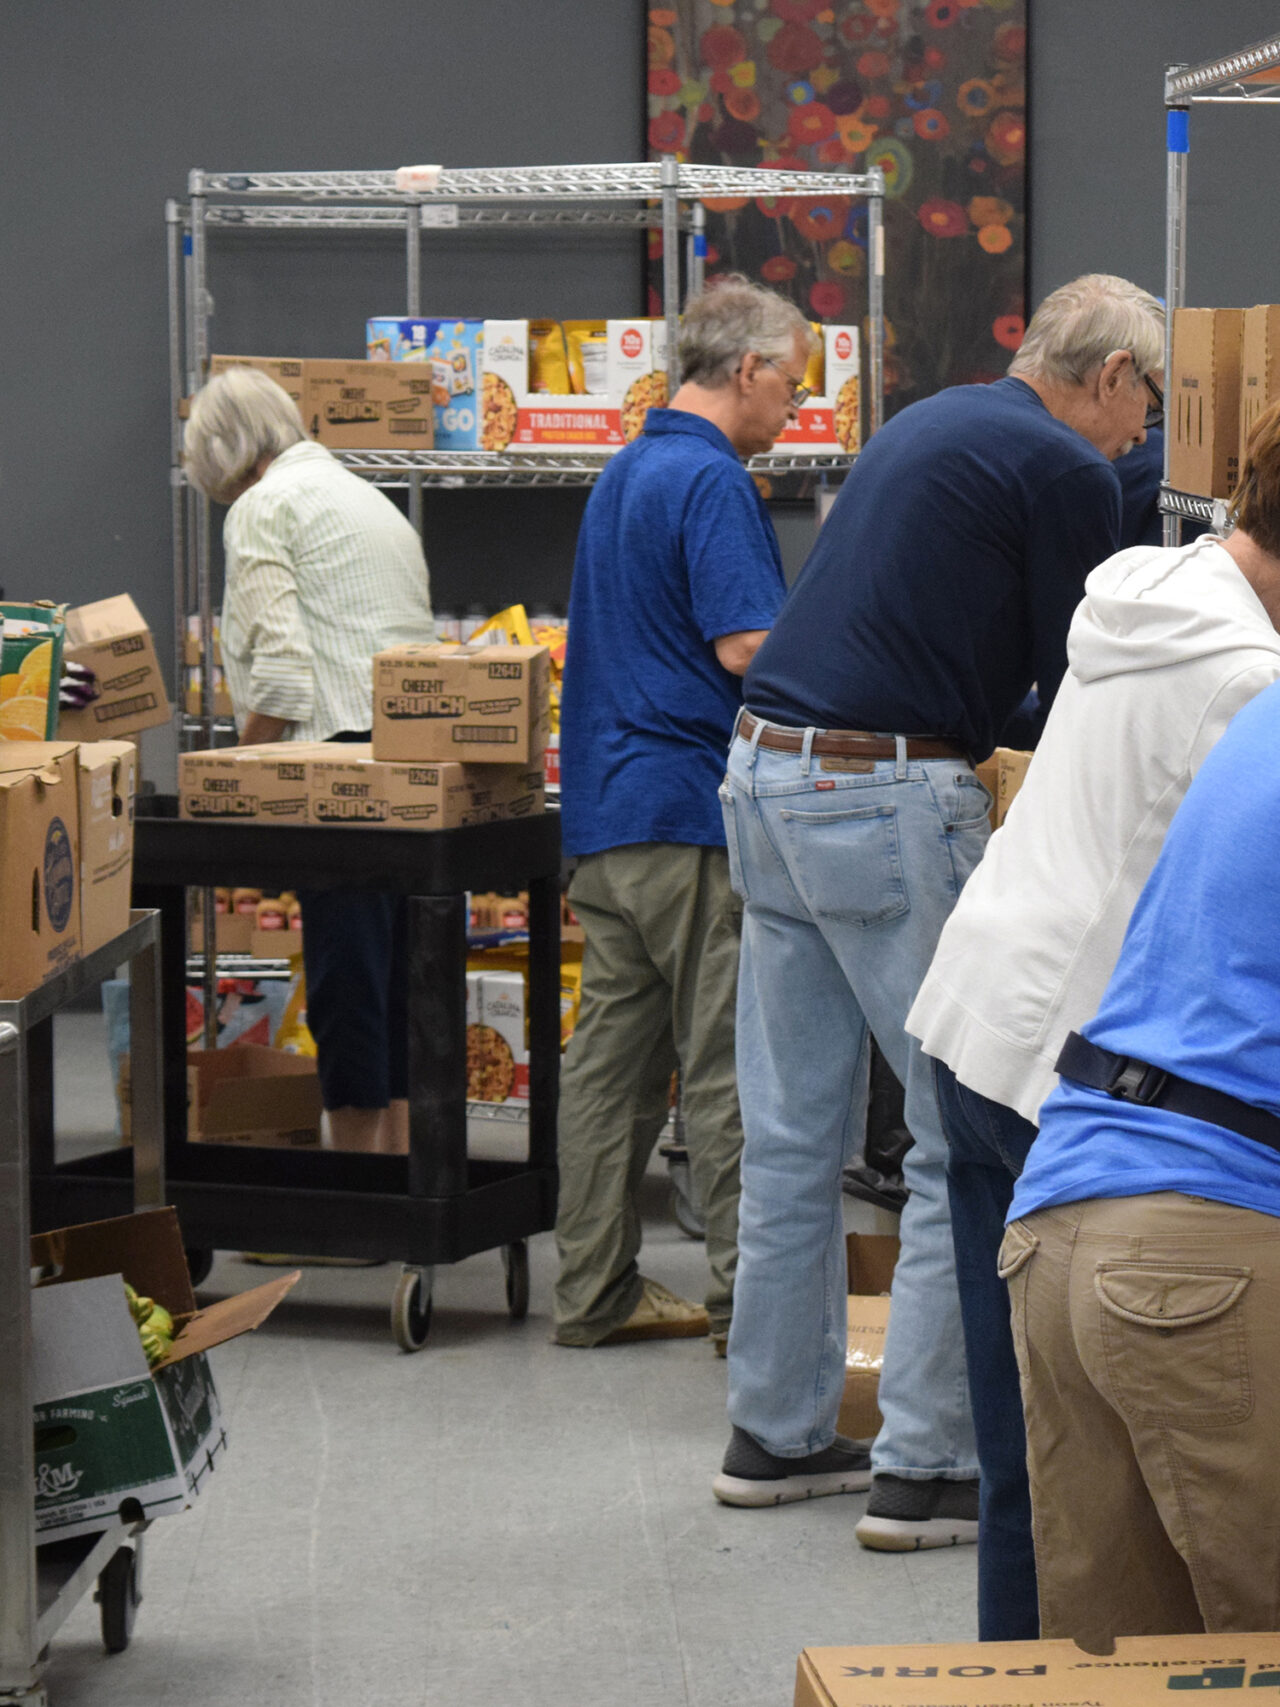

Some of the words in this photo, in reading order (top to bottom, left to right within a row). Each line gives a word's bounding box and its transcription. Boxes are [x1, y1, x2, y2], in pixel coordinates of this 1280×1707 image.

[443, 408, 475, 432] GO
[529, 412, 610, 430] TRADITIONAL
[488, 662, 522, 679] 12647
[381, 696, 466, 720] CRUNCH
[185, 795, 259, 818] CRUNCH
[313, 799, 390, 823] CRUNCH
[839, 1664, 1048, 1678] PORK
[1068, 1657, 1246, 1670] Excellence
